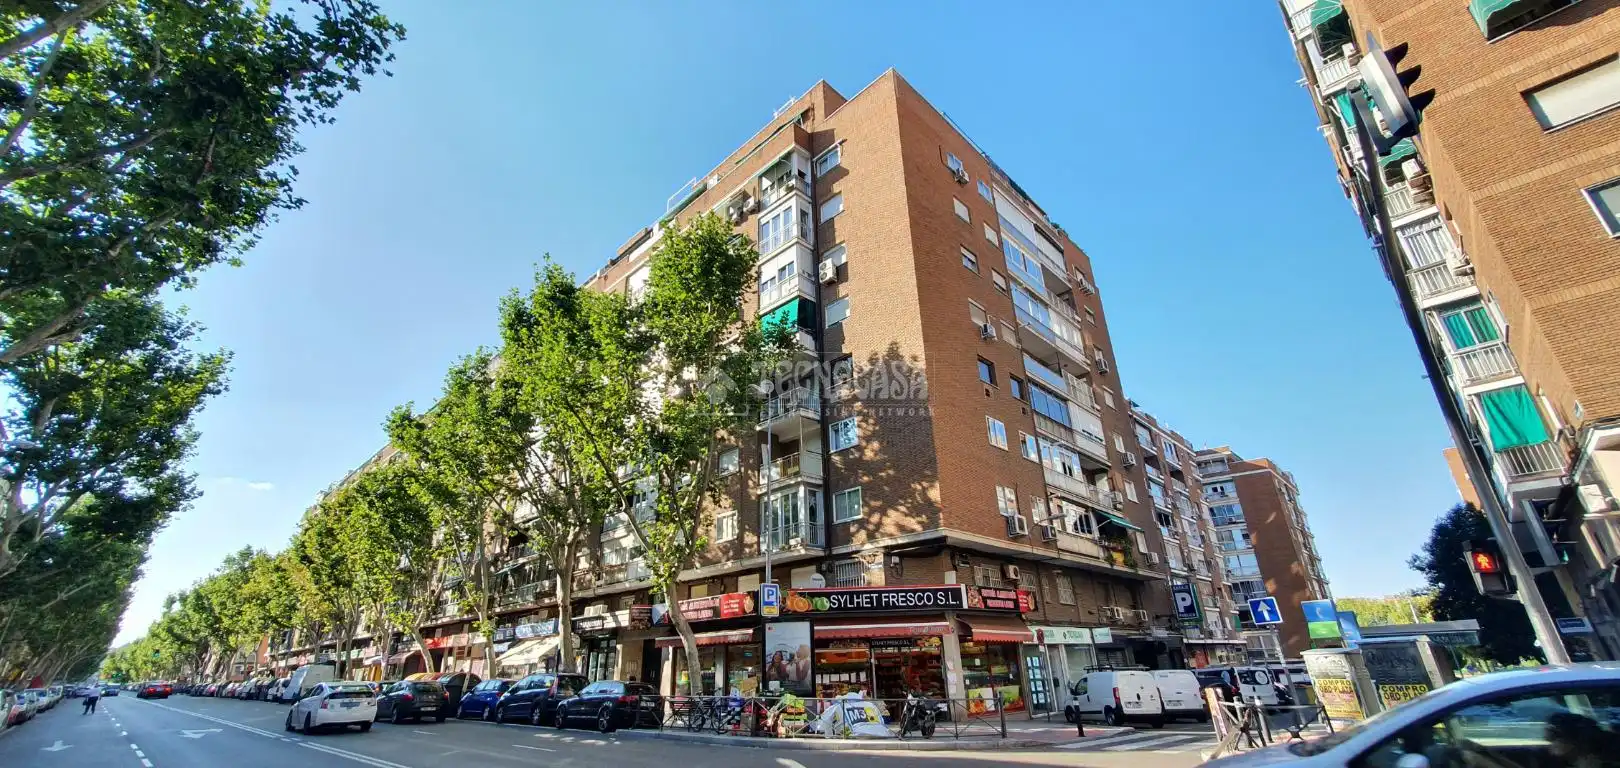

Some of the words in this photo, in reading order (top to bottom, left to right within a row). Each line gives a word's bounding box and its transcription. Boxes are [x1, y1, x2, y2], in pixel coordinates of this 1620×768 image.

[767, 589, 775, 600] P
[830, 593, 879, 608] SYLHET
[881, 592, 934, 607] FRESCO
[937, 591, 960, 605] S.L.
[1175, 592, 1192, 612] P
[1381, 685, 1426, 693] COMPRO
